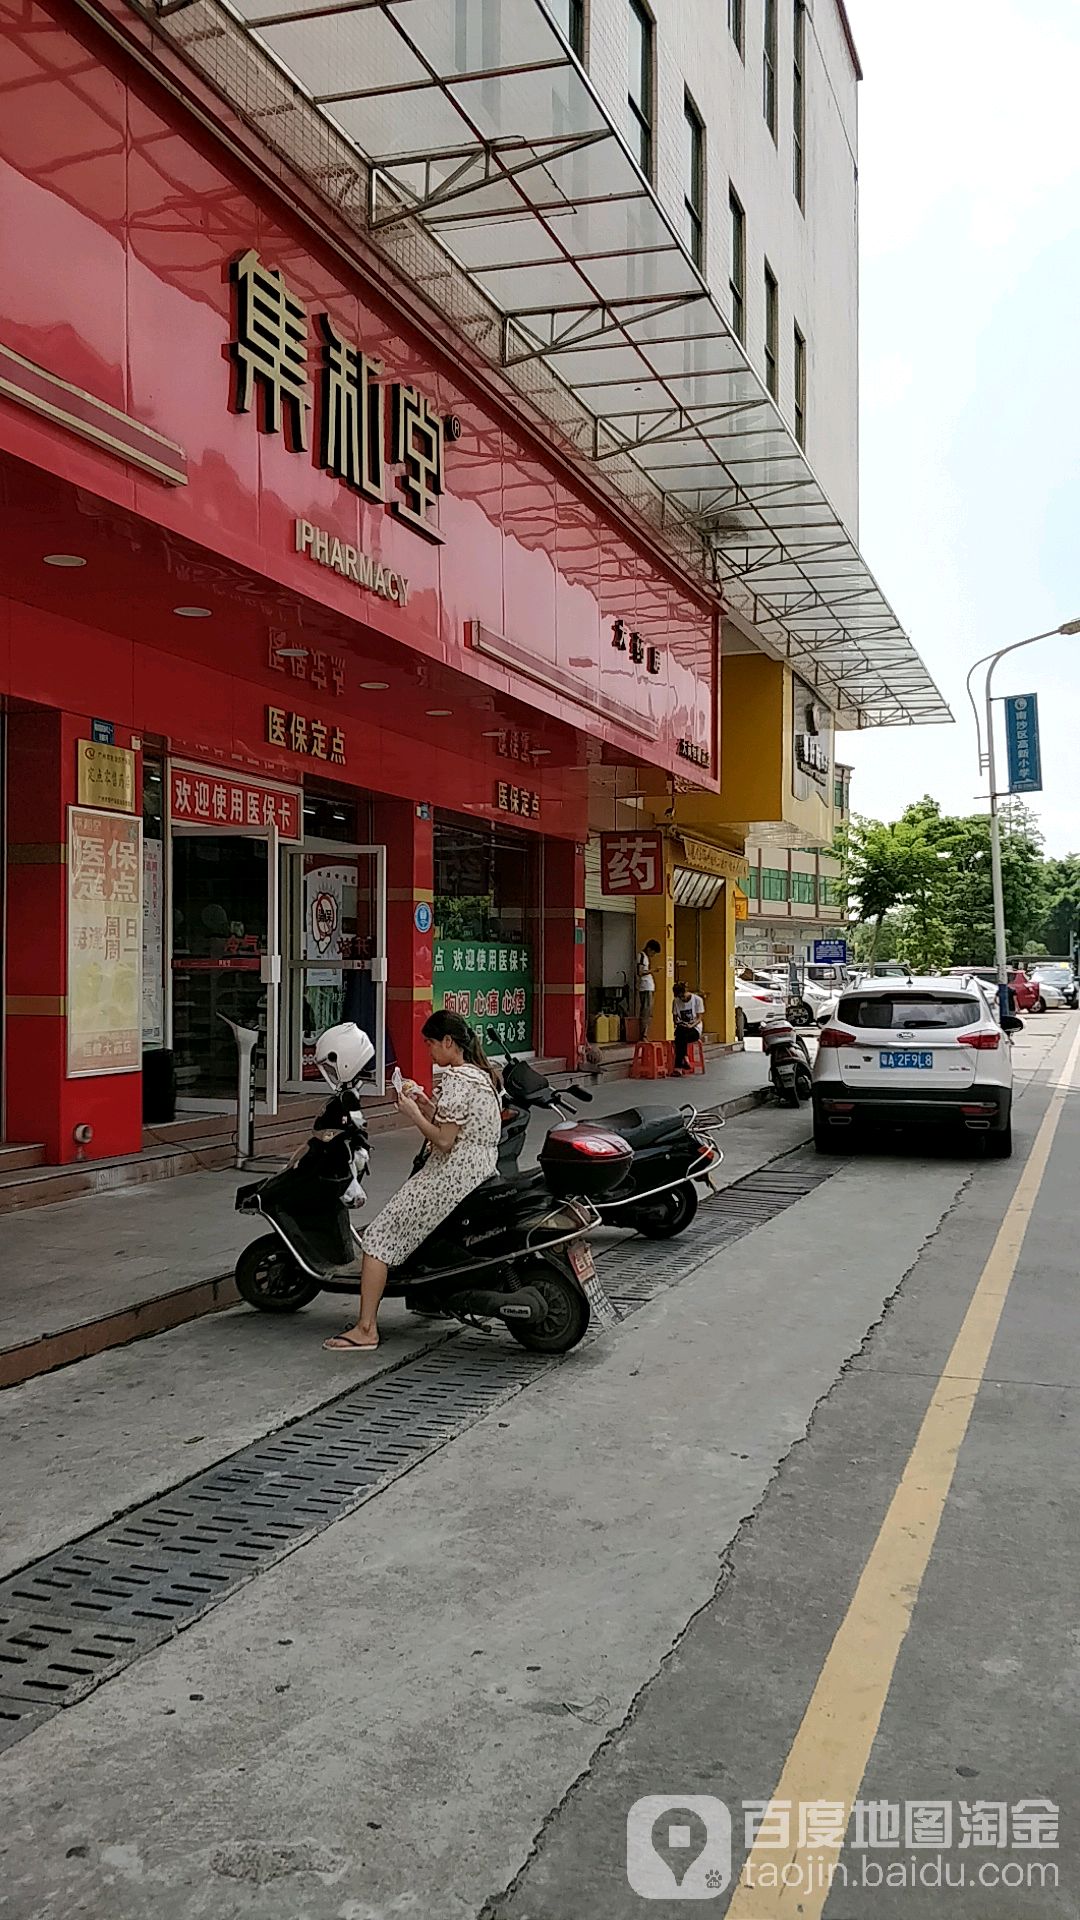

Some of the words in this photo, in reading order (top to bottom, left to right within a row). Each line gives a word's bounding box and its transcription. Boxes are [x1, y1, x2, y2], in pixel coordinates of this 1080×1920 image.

[228, 248, 446, 545] 集和堂
[296, 518, 410, 607] PHARMACY
[267, 705, 346, 764] 医保定点
[175, 777, 291, 831] 欢迎使用医保卡
[498, 781, 540, 819] 医保定点
[76, 835, 137, 870] 医保
[607, 838, 657, 891] 药
[76, 868, 137, 902] 定点
[104, 916, 138, 938] 周日
[224, 934, 259, 955] 冷气
[104, 939, 139, 961] 周一
[434, 946, 445, 972] 点
[453, 947, 528, 972] 欢迎使用医保卡
[474, 989, 499, 1016] 心痛
[502, 988, 526, 1015] 心悸
